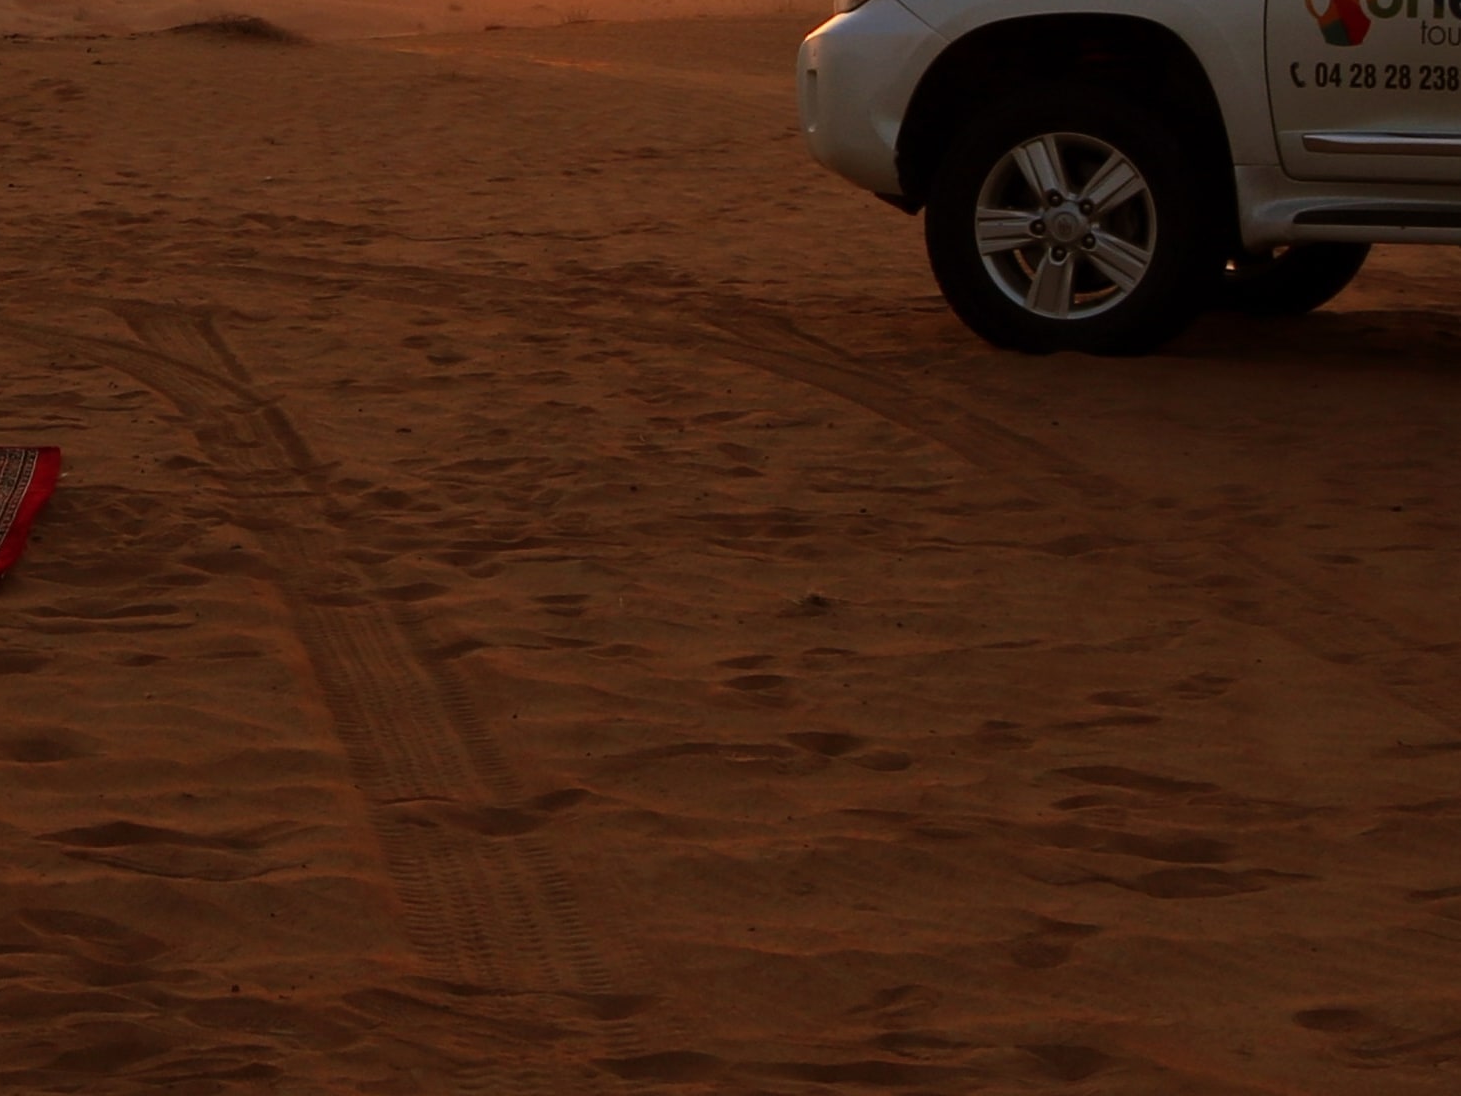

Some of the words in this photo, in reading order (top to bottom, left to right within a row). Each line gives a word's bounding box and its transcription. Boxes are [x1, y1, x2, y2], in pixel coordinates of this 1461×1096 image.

[1315, 61, 1342, 88] 04
[1350, 62, 1377, 89] 28
[1384, 63, 1411, 90] 28
[1419, 64, 1460, 92] 238
